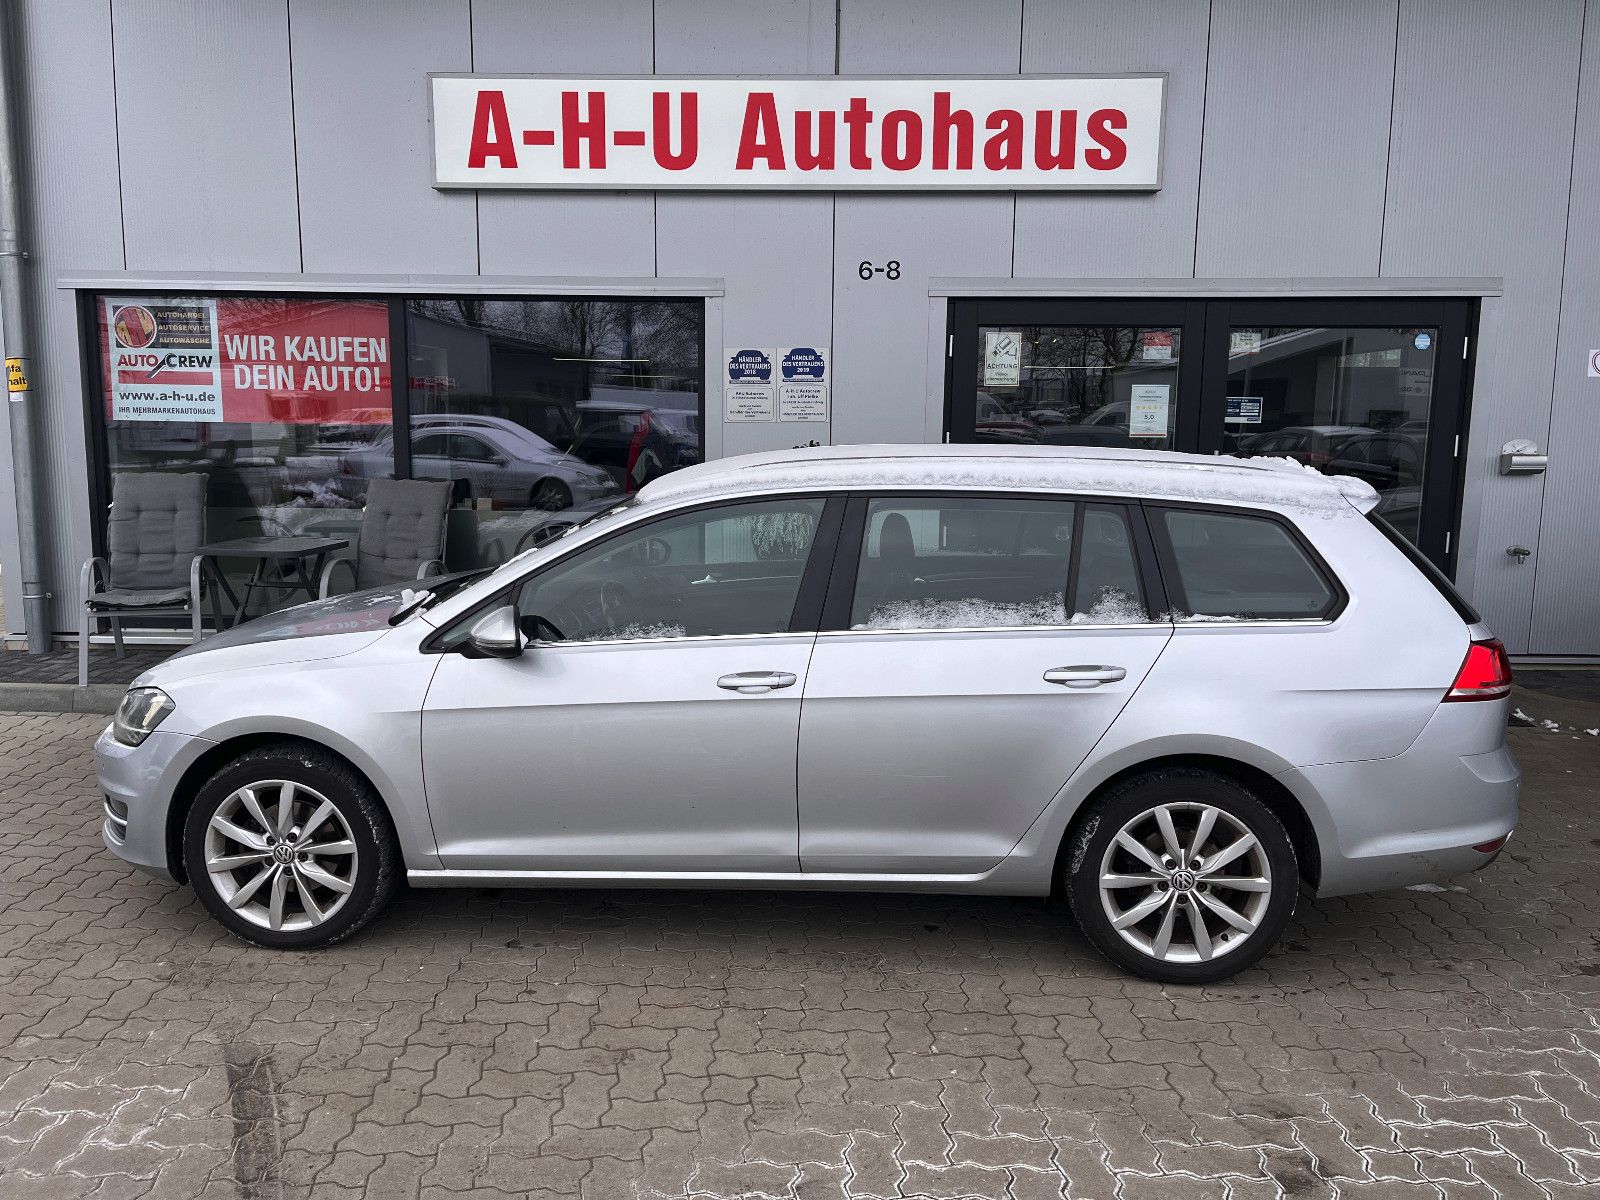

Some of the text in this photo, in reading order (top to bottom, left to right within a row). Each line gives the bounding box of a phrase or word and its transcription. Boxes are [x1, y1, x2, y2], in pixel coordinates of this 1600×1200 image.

[467, 91, 1128, 172] A-H-U Autohaus
[858, 260, 901, 281] 6-8
[156, 310, 206, 319] AUTOHANDEL
[158, 324, 210, 332] AUTOSERVICE
[223, 334, 387, 363] WIR KAUFEN
[738, 355, 762, 363] HÄNDLER
[233, 364, 295, 391] DEIN
[302, 365, 381, 392] AUTO!
[118, 391, 216, 402] www.a-h-u.de
[118, 406, 216, 415] IHR MEHRMARKENAUTOHAUS
